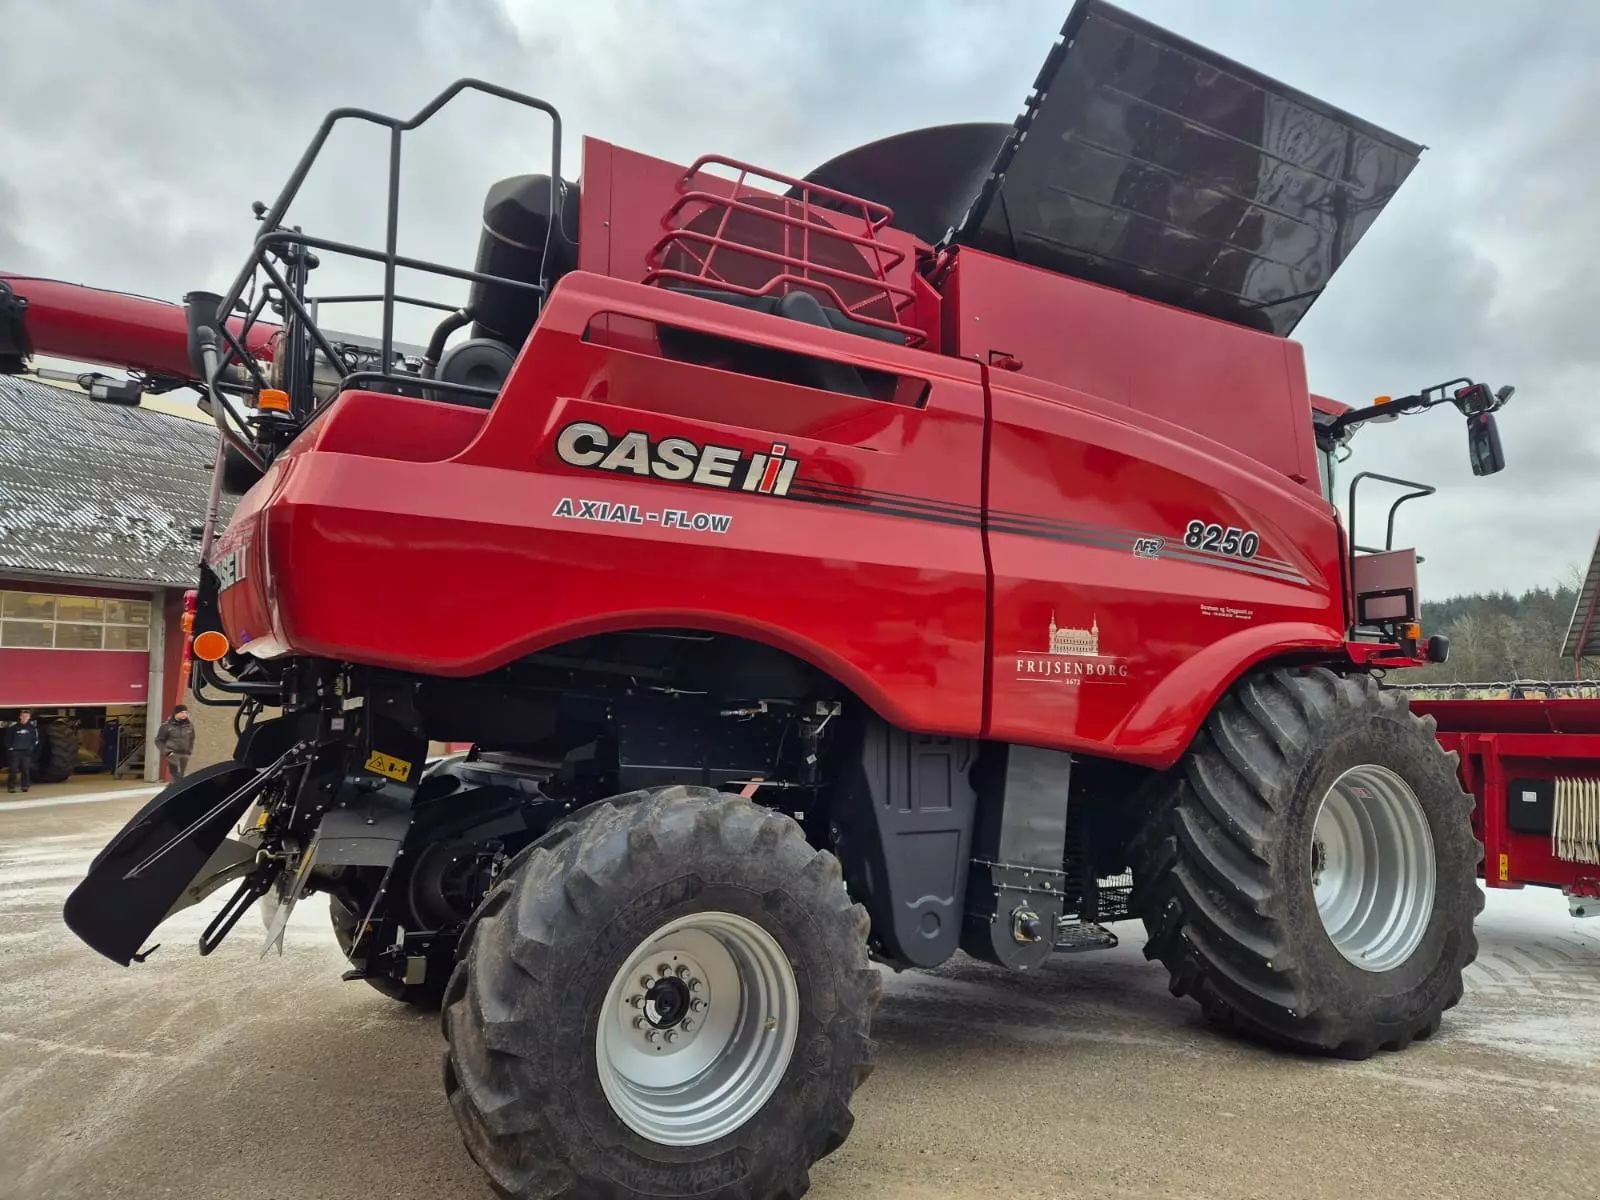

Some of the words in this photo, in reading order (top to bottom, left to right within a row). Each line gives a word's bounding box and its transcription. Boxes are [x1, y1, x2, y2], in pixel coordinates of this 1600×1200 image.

[557, 422, 741, 487] CASE
[1133, 538, 1160, 554] AFS
[1184, 520, 1259, 559] 8250
[1016, 659, 1128, 677] FRIJSENBORG
